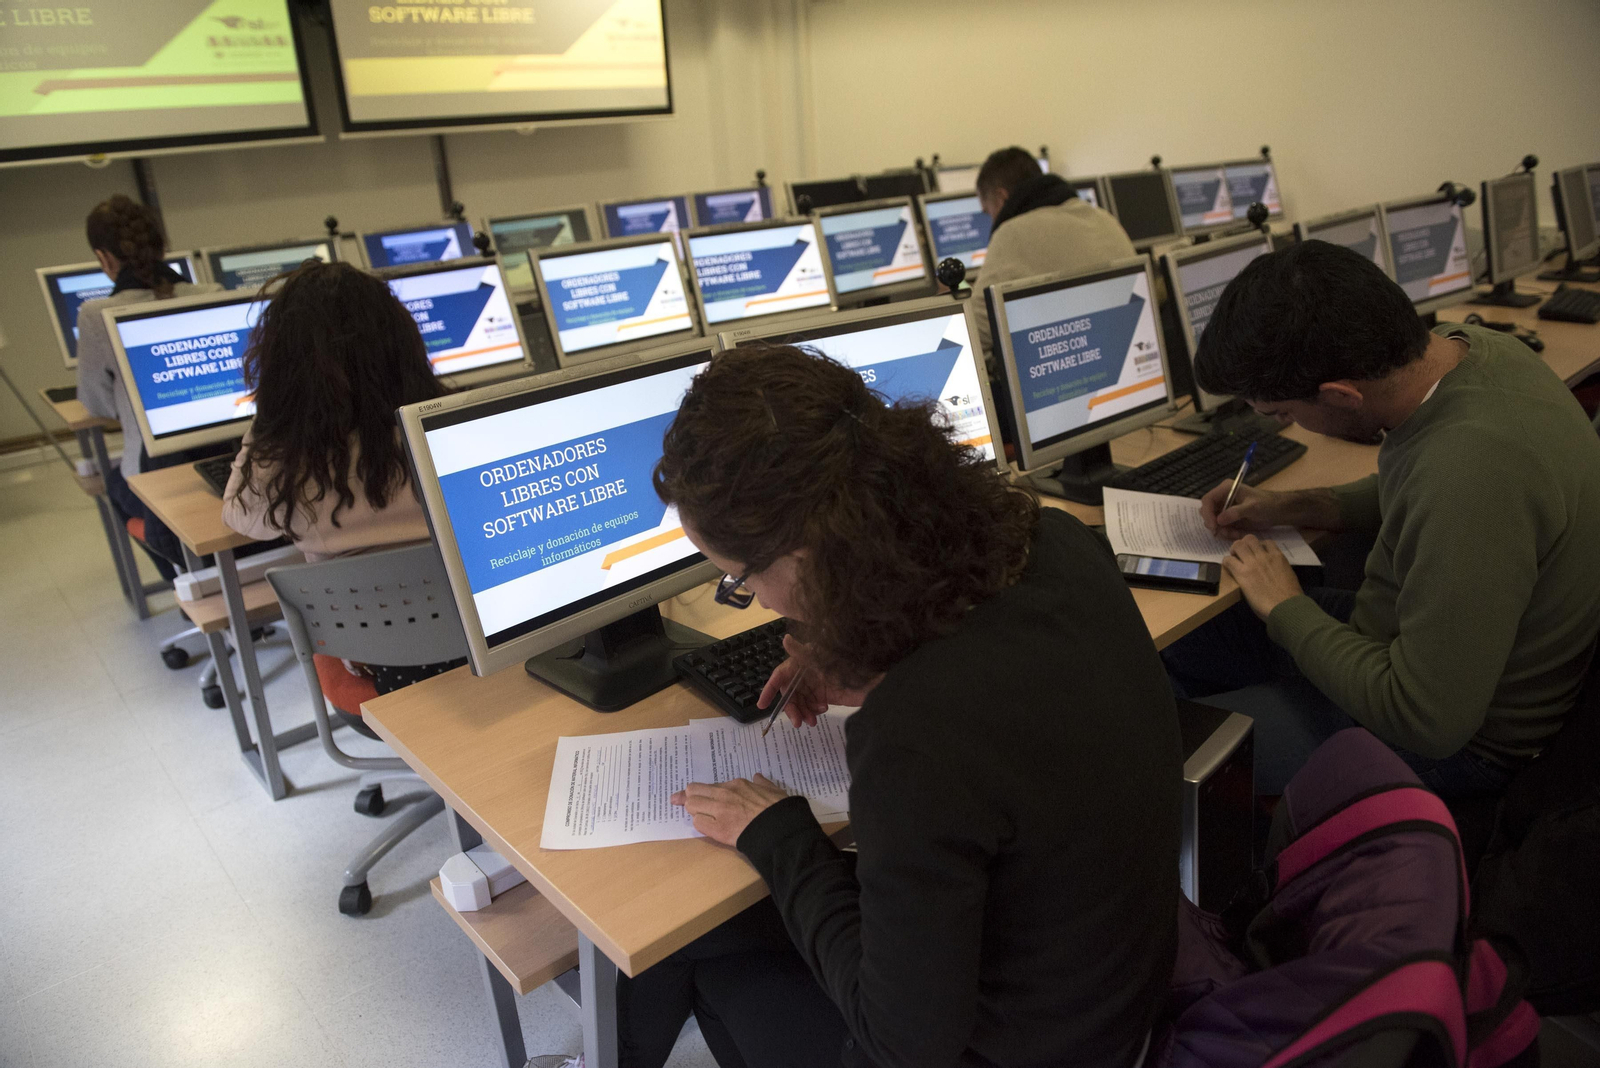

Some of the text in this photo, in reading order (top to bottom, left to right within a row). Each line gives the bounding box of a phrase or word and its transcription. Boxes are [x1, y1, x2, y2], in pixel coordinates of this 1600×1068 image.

[11, 7, 93, 26] LIBRE
[368, 6, 534, 24] SOFTWARE LIBRE
[411, 311, 430, 323] ON
[1028, 317, 1092, 344] ORDENADORES
[150, 332, 239, 356] ORDENADORES
[1038, 335, 1088, 359] LIBRES CON
[164, 346, 234, 368] LIBRES CON
[1029, 347, 1102, 379] SOFTWARE LIBRE
[152, 361, 219, 384] SOFTWARE
[418, 402, 442, 412] E1904W
[480, 437, 607, 488] ORDENADORES
[500, 463, 600, 508] LIBRES CON
[483, 478, 628, 539] SOFTWARE LIBRE
[489, 510, 639, 570] Reciclaje y donación de equipos
[541, 538, 602, 566] informáticos
